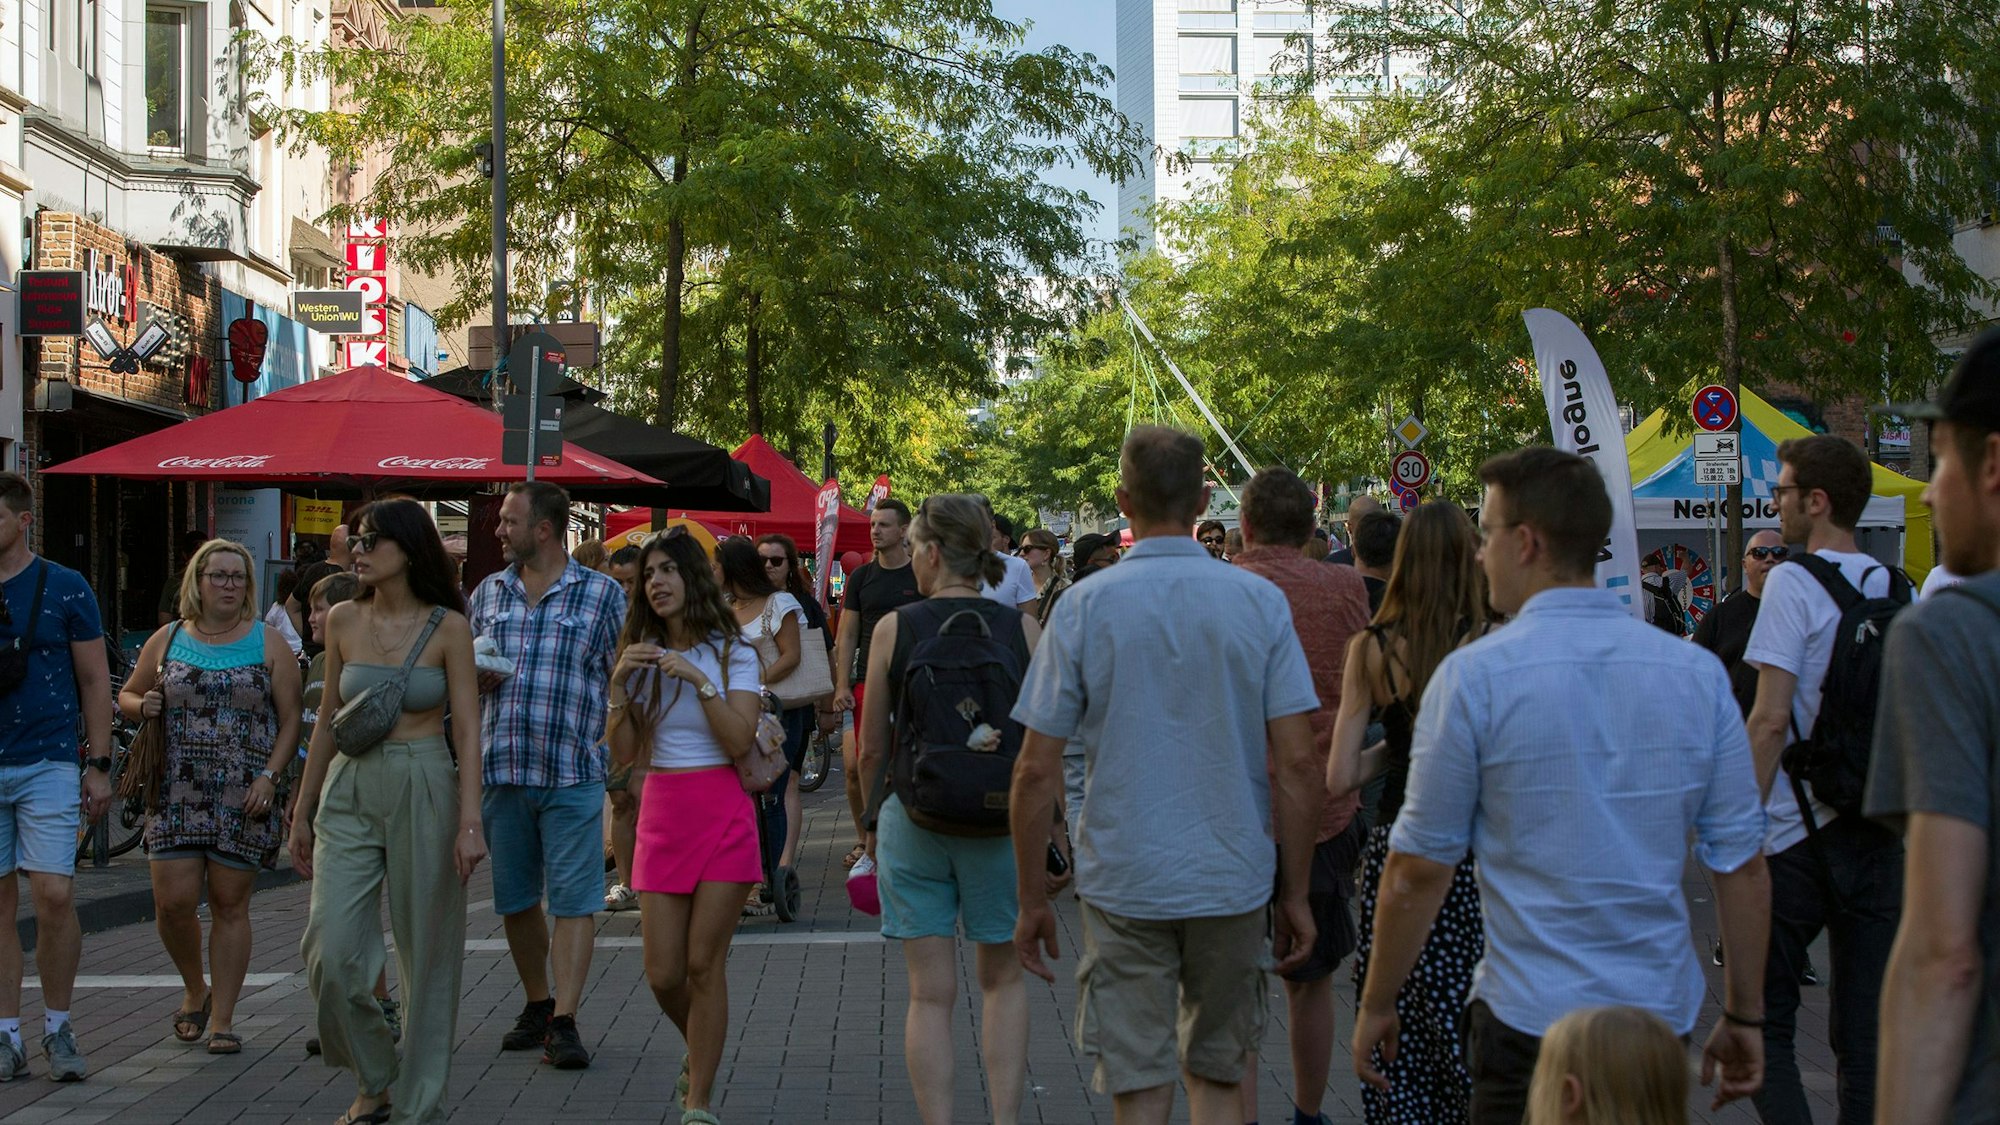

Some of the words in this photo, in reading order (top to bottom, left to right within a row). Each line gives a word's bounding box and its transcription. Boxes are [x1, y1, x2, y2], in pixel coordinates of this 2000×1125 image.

[298, 304, 339, 313] Western
[311, 312, 339, 321] Union
[1400, 461, 1421, 478] 30
[217, 496, 255, 505] orona
[1674, 499, 1782, 522] Netolo
